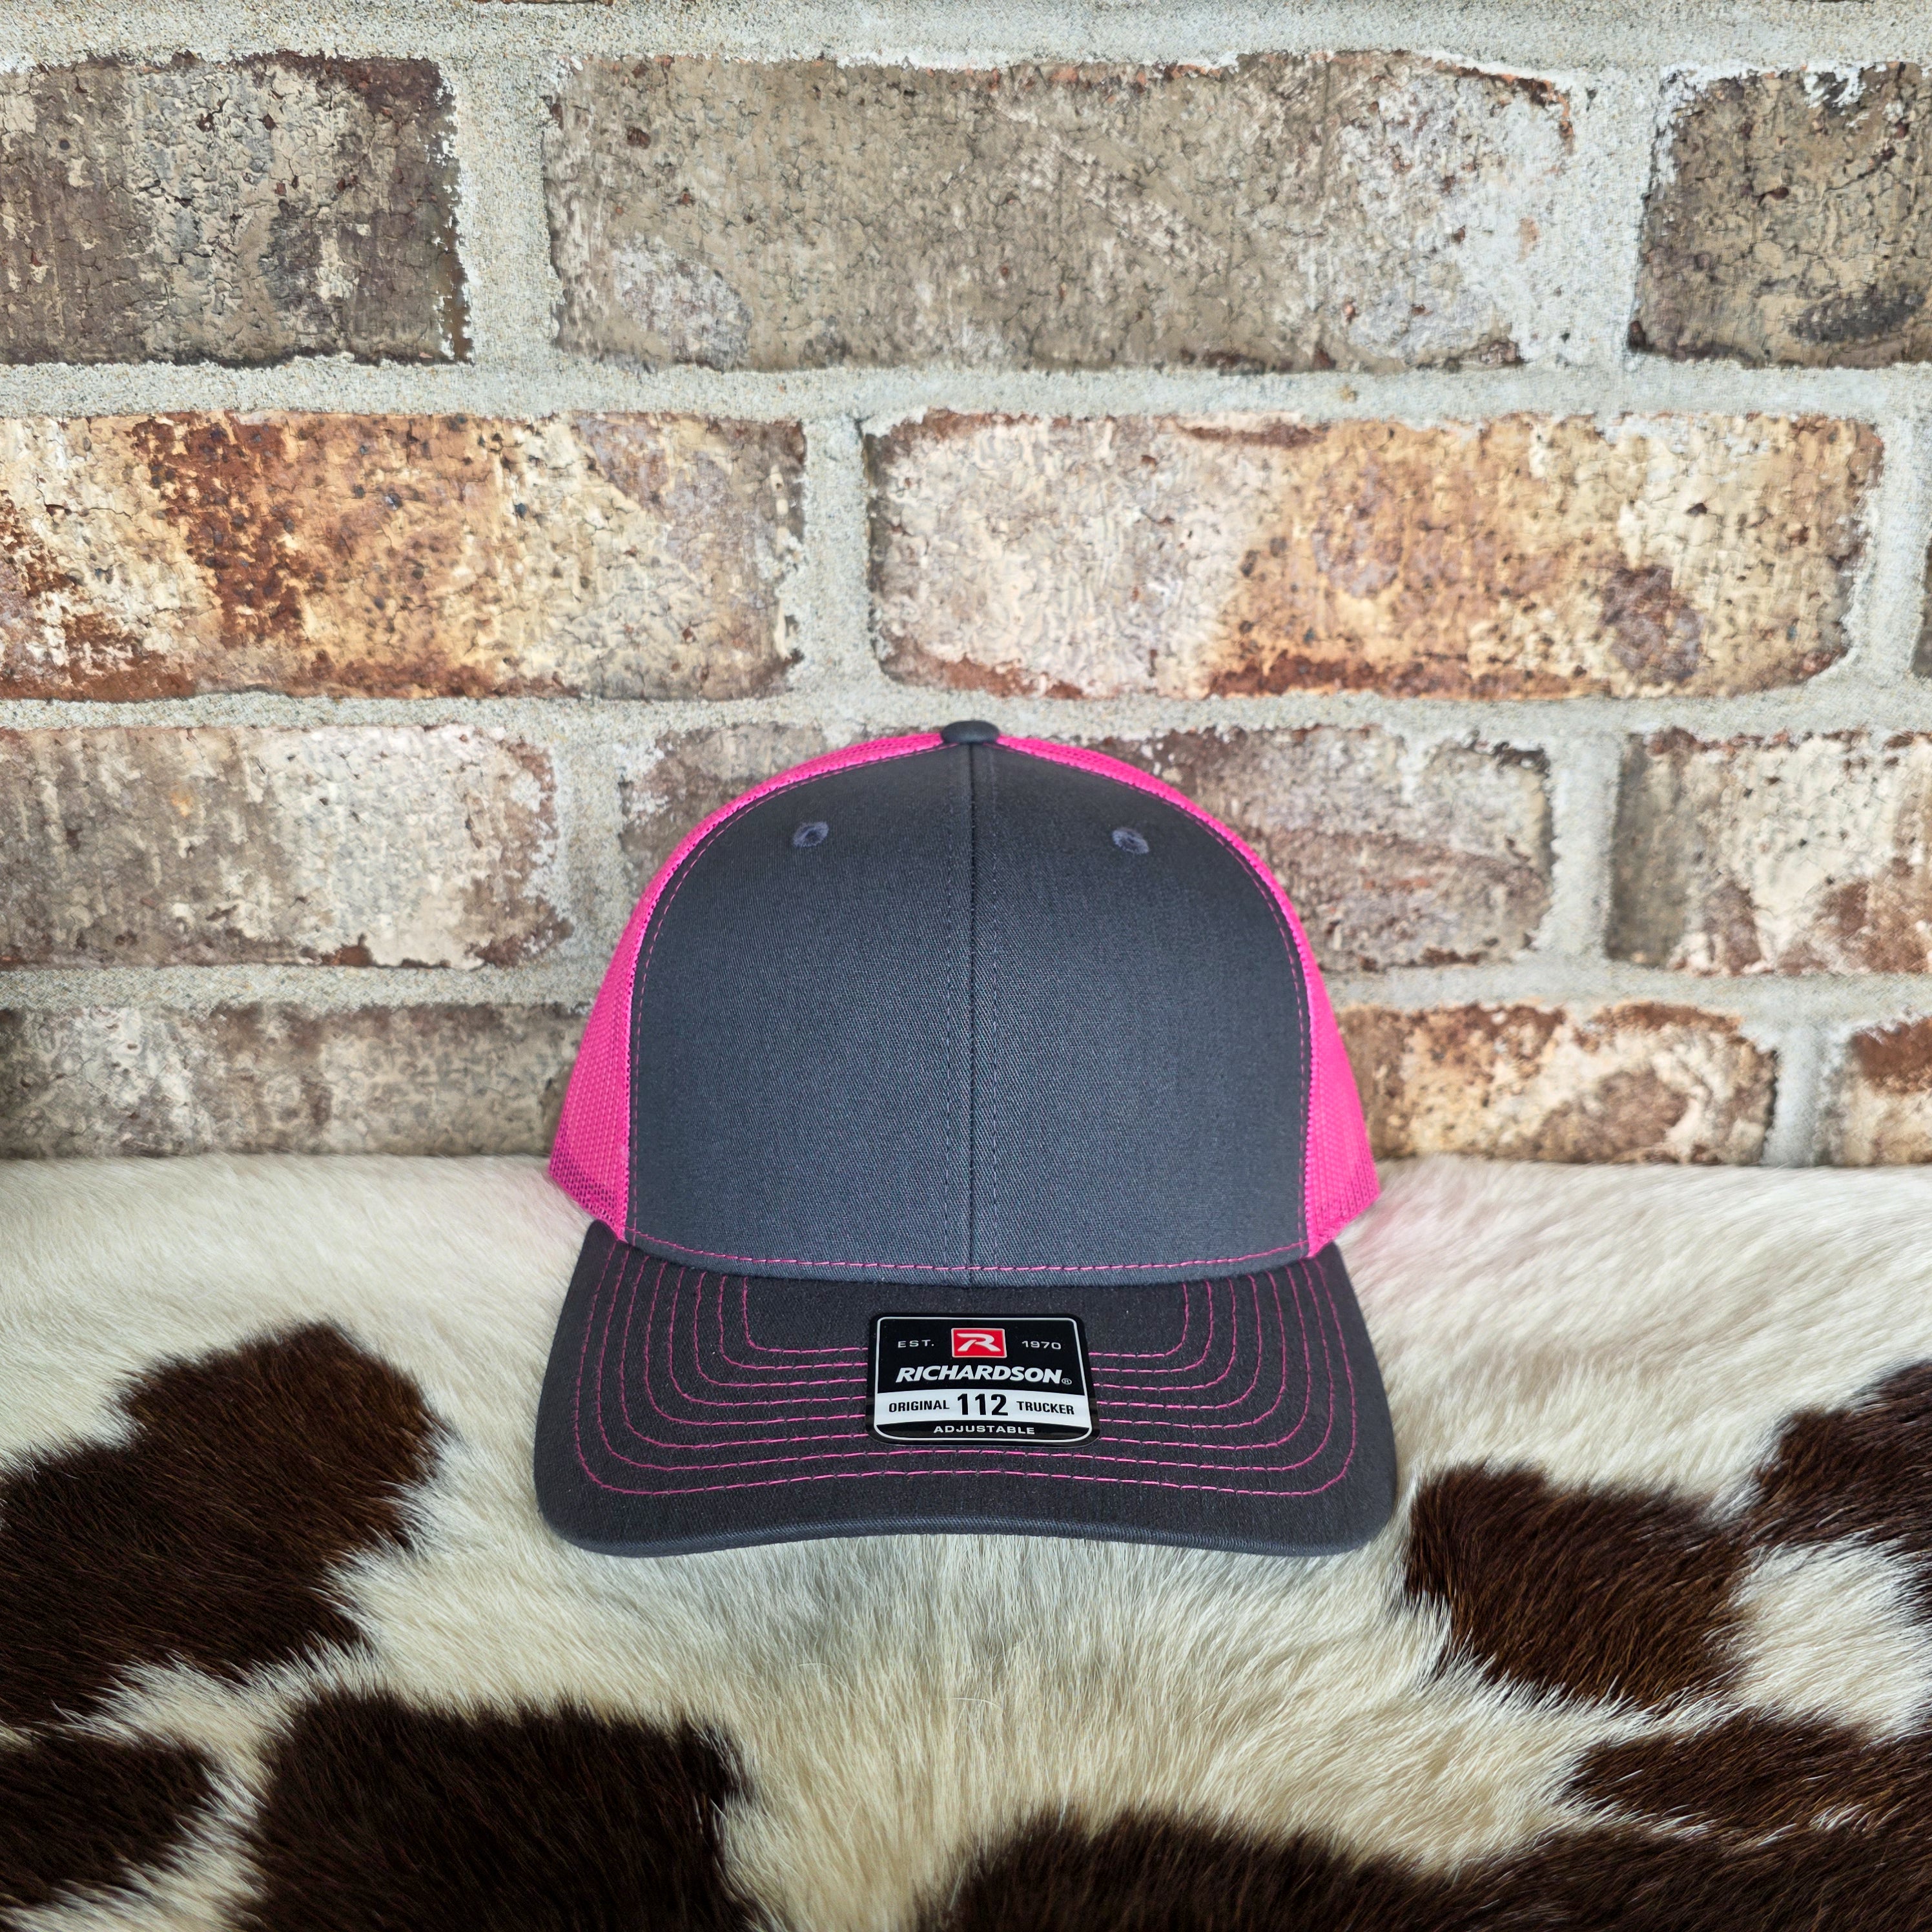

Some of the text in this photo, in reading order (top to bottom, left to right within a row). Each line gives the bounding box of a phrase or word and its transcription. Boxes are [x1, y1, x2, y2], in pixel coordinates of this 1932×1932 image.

[898, 1339, 1062, 1350] EST. 1970
[889, 1393, 1075, 1416] ORIGINAL 112 TRUCKER
[933, 1425, 1035, 1435] ADJUSTABLE
